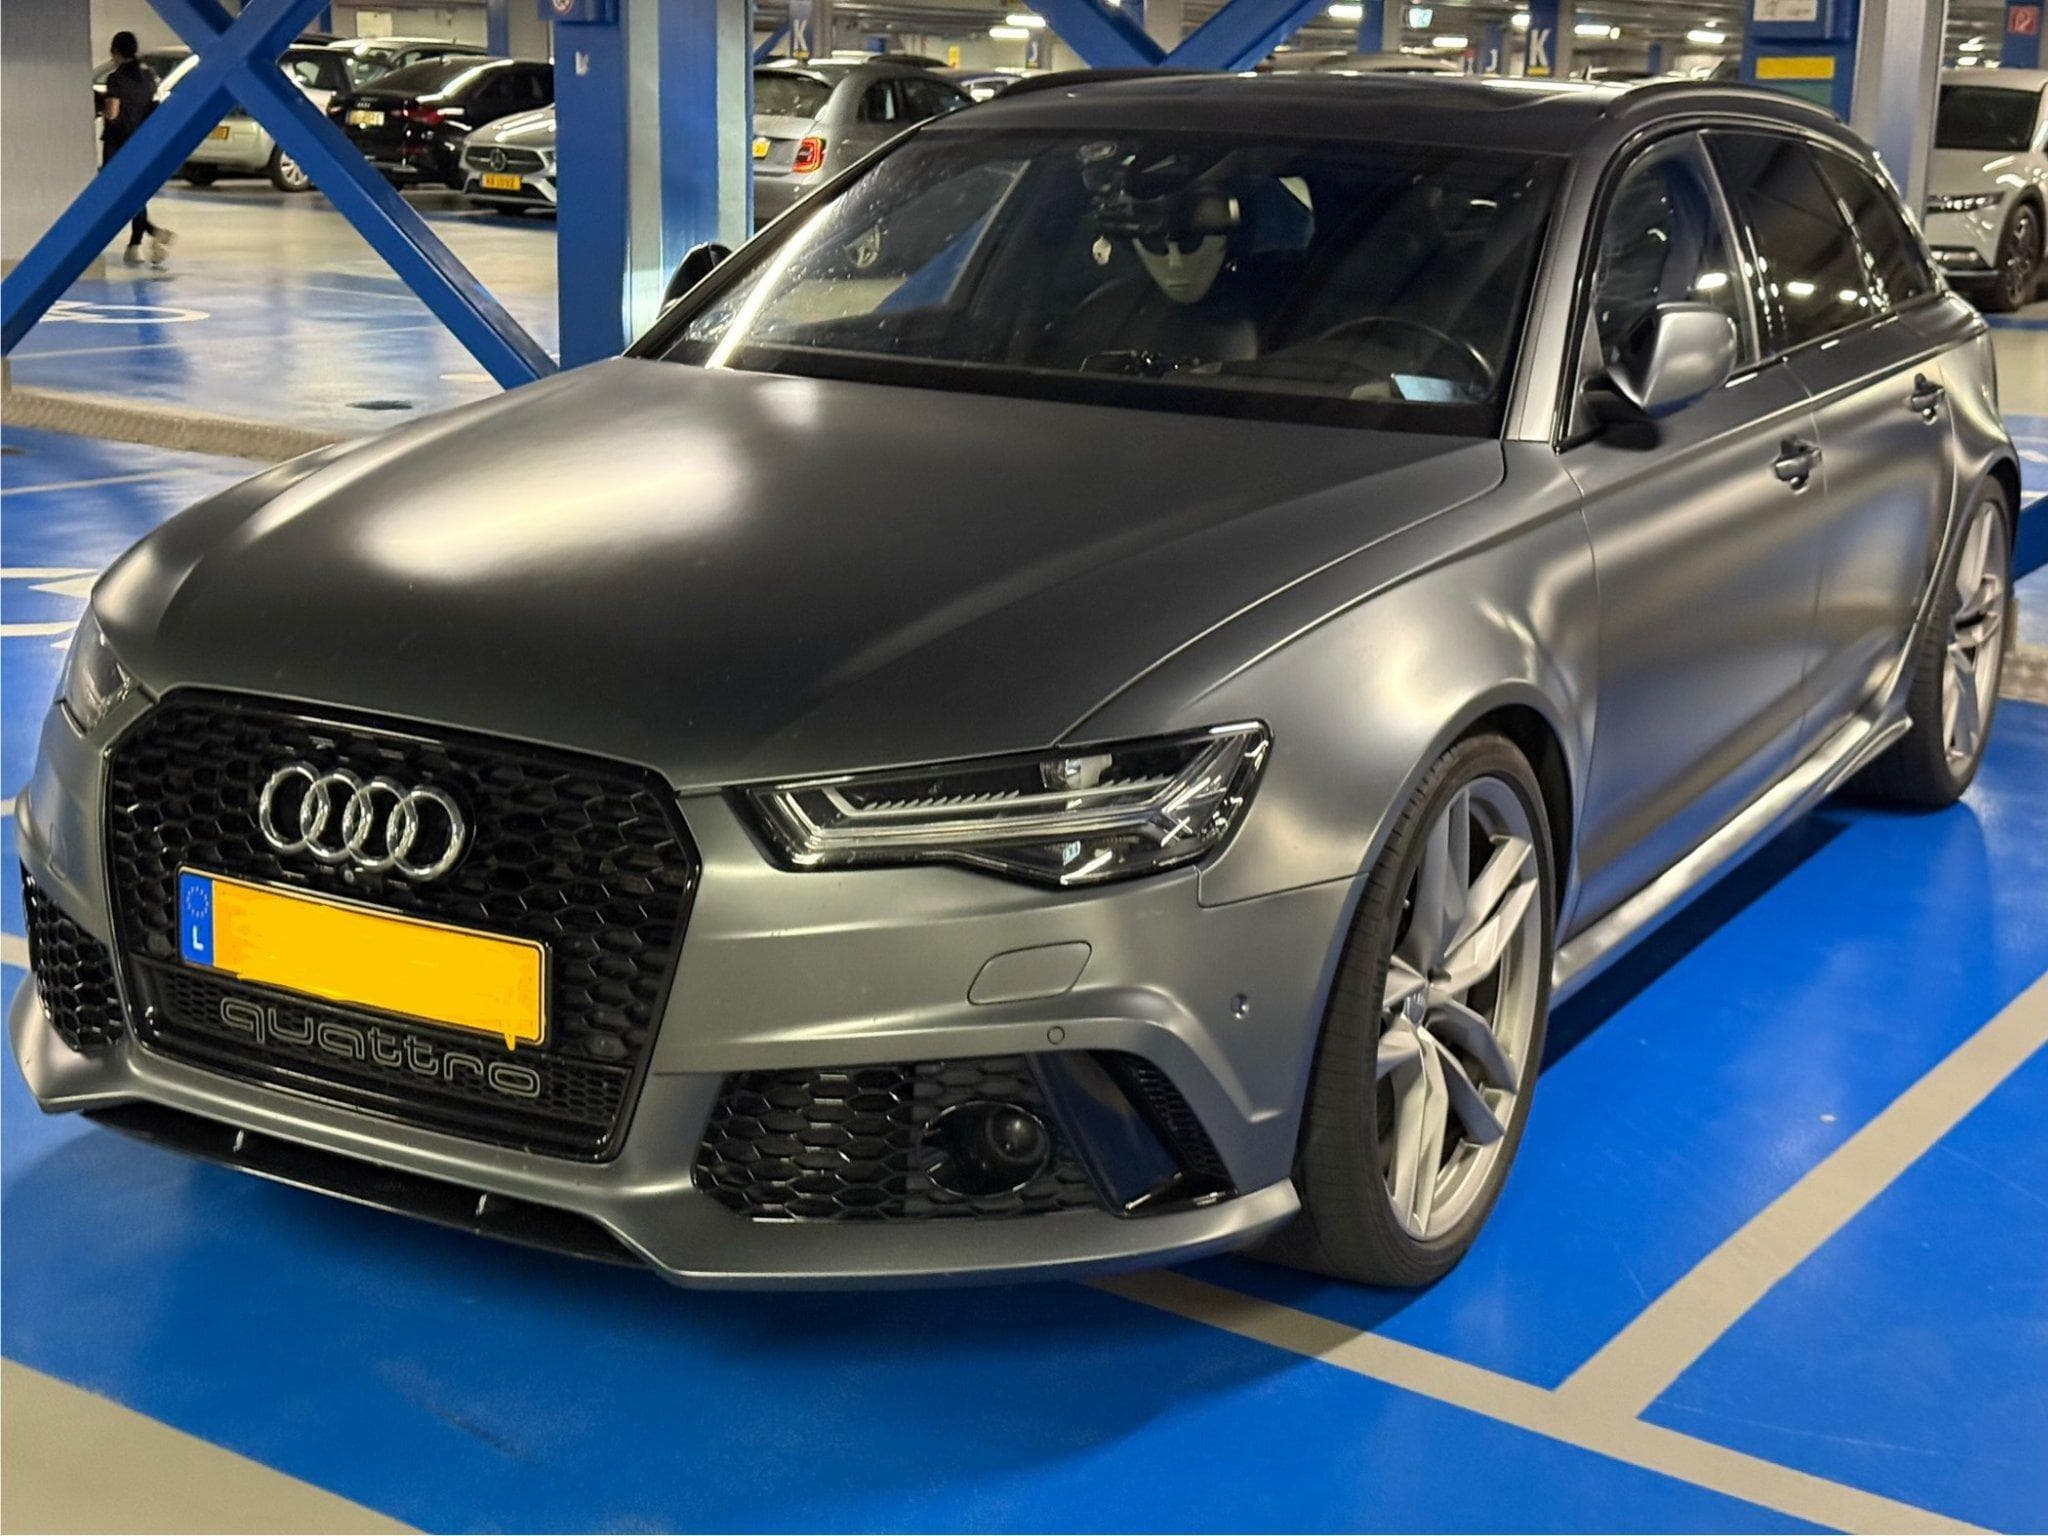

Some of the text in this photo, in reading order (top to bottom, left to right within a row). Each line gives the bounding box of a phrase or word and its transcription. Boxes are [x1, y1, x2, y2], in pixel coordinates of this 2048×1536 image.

[794, 19, 807, 51] K
[1529, 28, 1550, 66] K
[1485, 48, 1498, 72] J
[220, 997, 541, 1098] quattro
